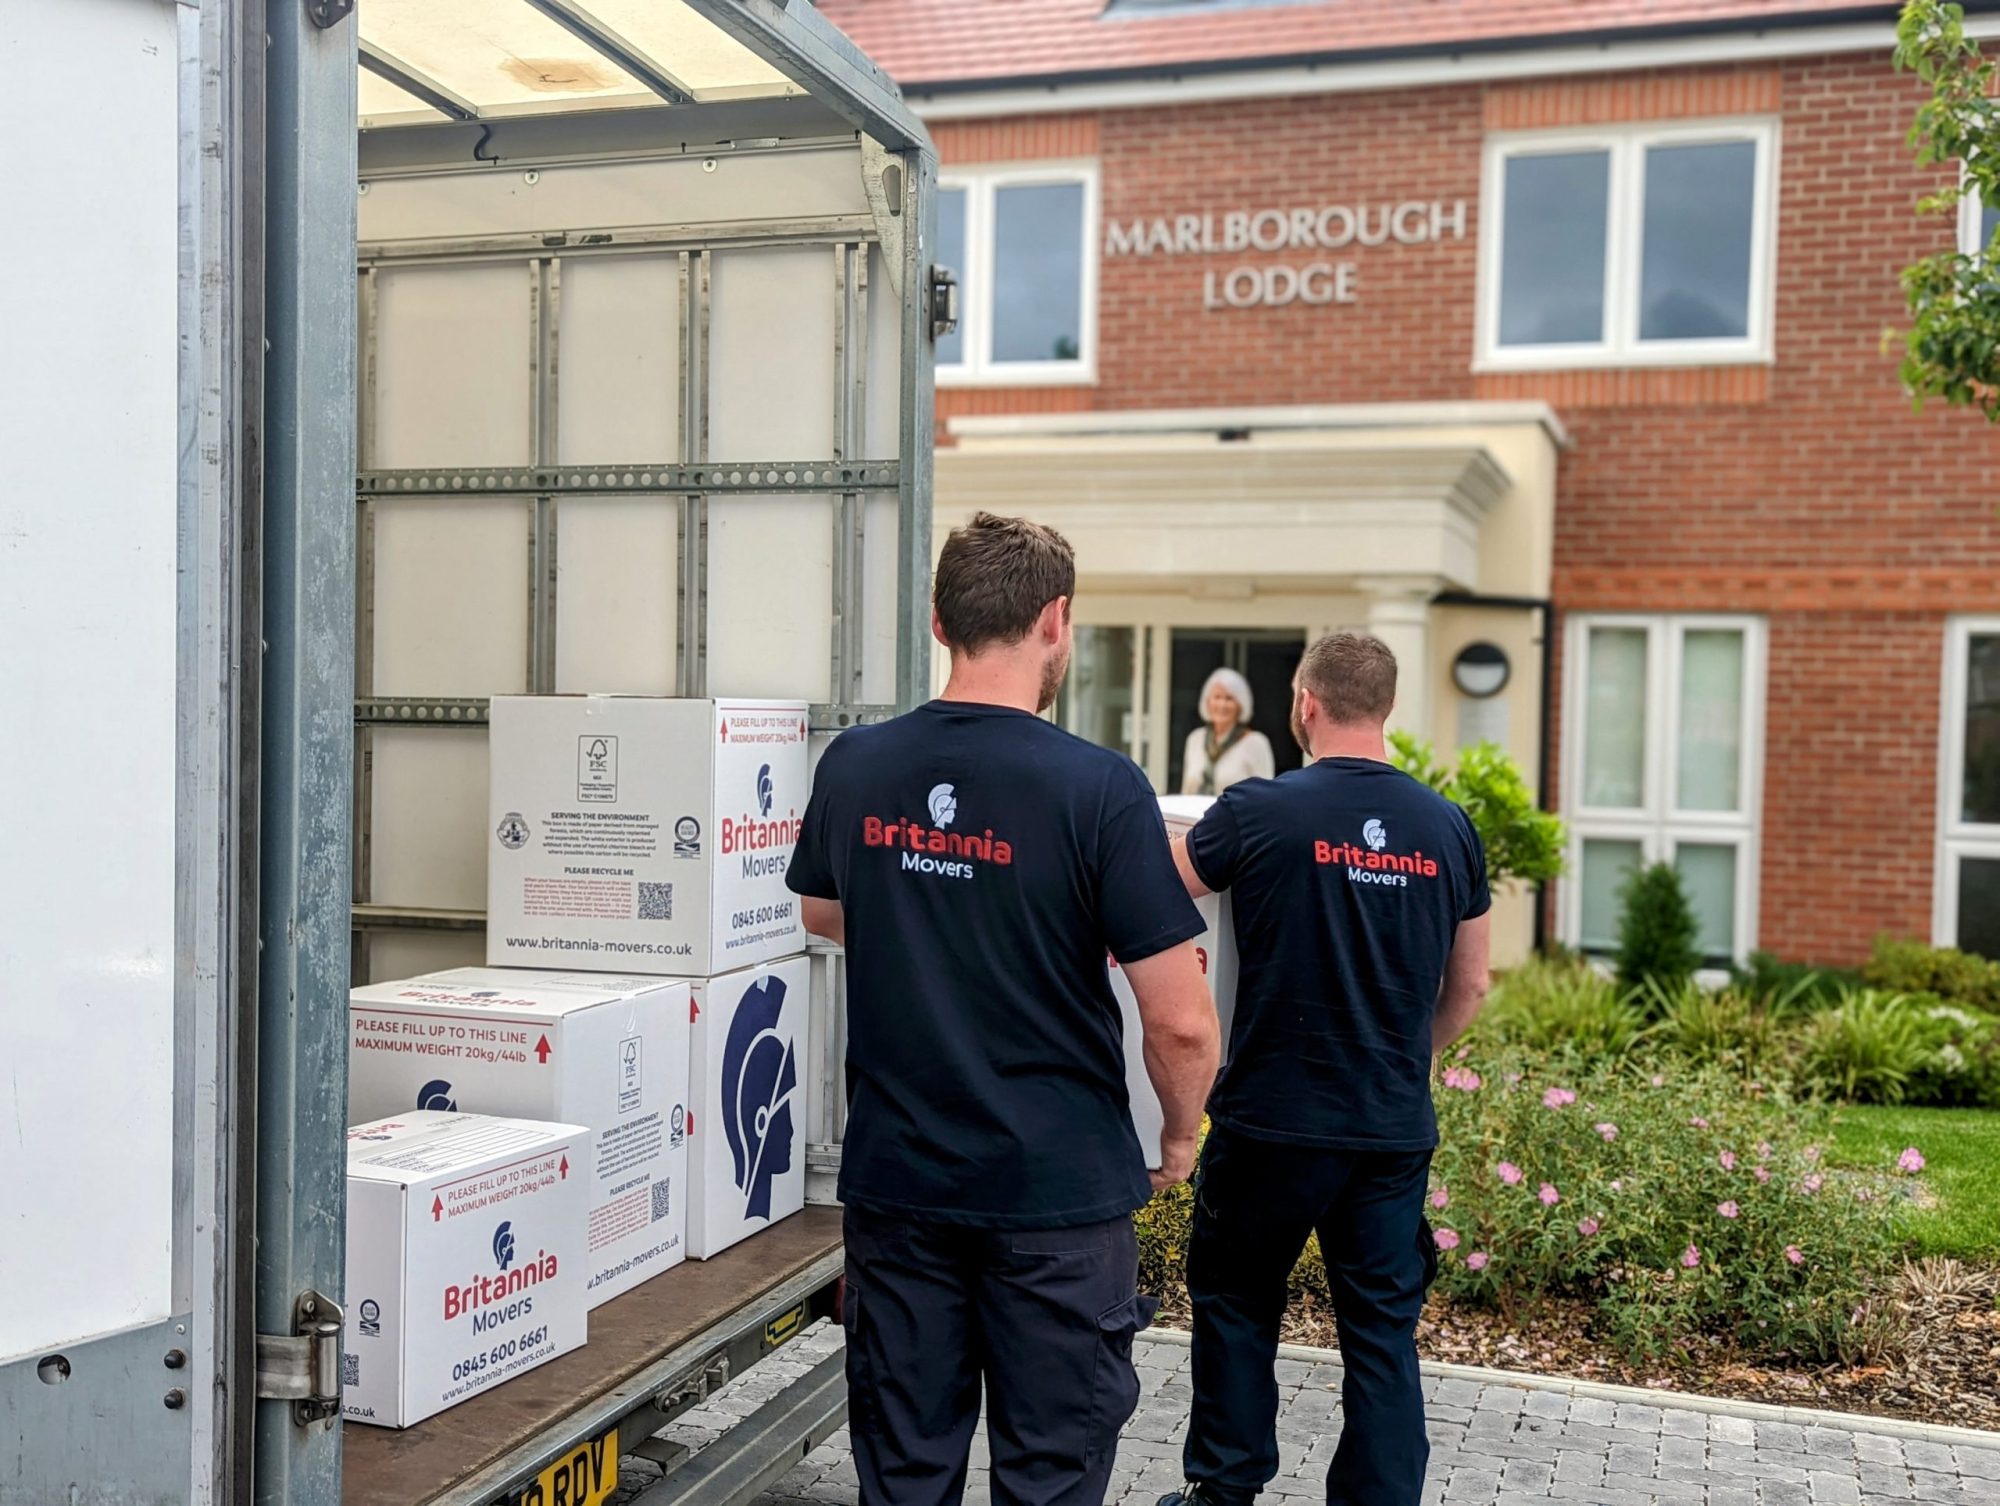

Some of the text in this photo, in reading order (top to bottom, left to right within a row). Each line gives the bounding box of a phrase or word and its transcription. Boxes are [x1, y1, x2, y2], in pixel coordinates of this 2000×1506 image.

[1105, 200, 1466, 256] MARLBOROUGH
[1204, 263, 1358, 311] LODGE
[590, 760, 607, 768] FSC
[551, 812, 581, 820] SERVING
[722, 809, 803, 854] Britannia
[864, 816, 1012, 865] Britannia
[742, 854, 786, 879] Movers
[901, 851, 974, 879] Movers
[1314, 840, 1438, 876] Britannia
[1348, 866, 1408, 887] Movers
[732, 902, 793, 929] 0845 600 6661
[506, 937, 692, 955] www.britannia-movers.co.uk
[725, 924, 797, 949] www.britannia-movers.co.uk
[398, 991, 537, 1006] Britannia
[356, 1019, 527, 1044] PLEASE FILL UP TO THIS LINE
[355, 1038, 527, 1063] MAXIMUM WEIGHT 20kg/44lb
[602, 1125, 621, 1139] SERVING
[621, 1122, 630, 1132] THE
[629, 1112, 659, 1129] ENVIRONMENT
[448, 1159, 555, 1202] PLEASE FILL UP TO THIS LINE
[609, 1183, 626, 1197] PLEASE
[625, 1175, 644, 1190] RECYCLE
[448, 1175, 556, 1218] MAXIMUM WEIGHT 20kg/44lb
[444, 1249, 557, 1320] Britannia
[472, 1297, 533, 1336] Movers
[452, 1325, 548, 1382] 0845 600 6661
[442, 1342, 557, 1402] www.britannia-movers.co.uk
